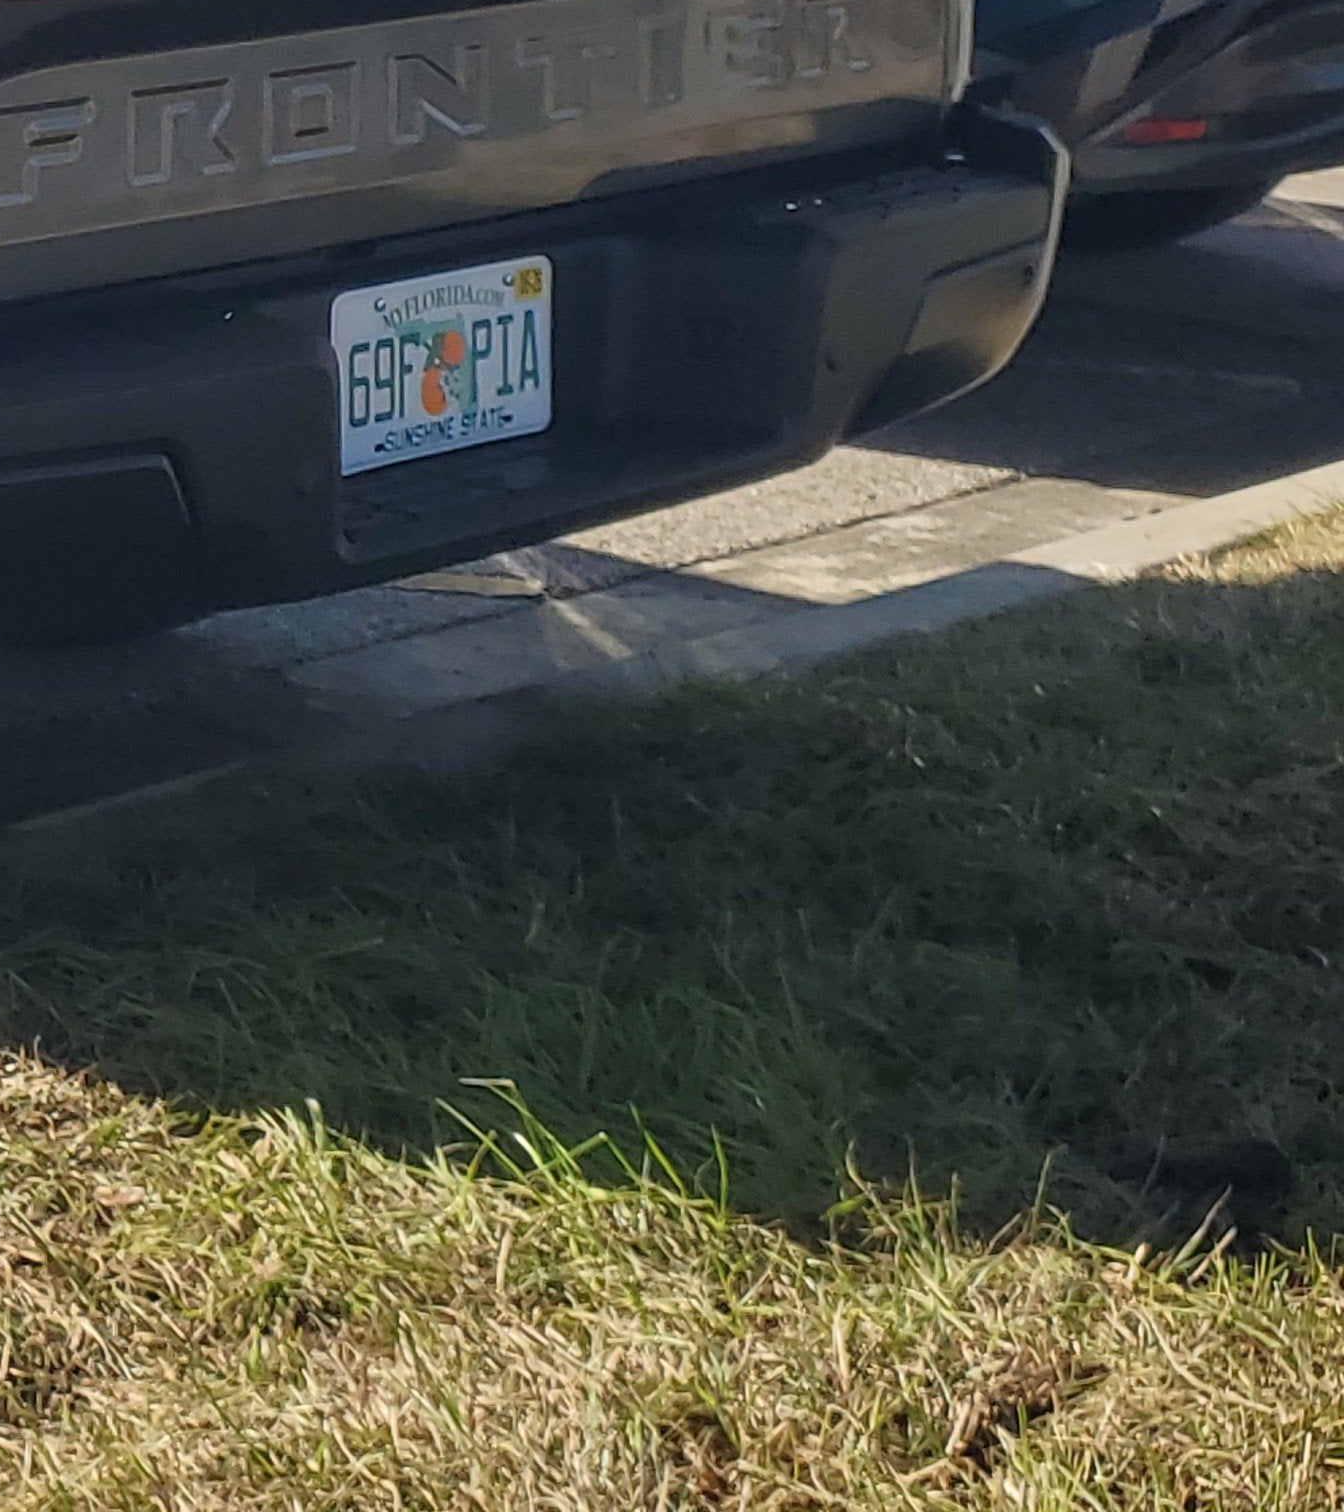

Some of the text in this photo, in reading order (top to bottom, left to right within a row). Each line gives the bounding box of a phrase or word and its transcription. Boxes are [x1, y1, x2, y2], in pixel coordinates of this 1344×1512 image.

[471, 309, 541, 403] PIA
[384, 405, 506, 453] SUNSHINE STATE
